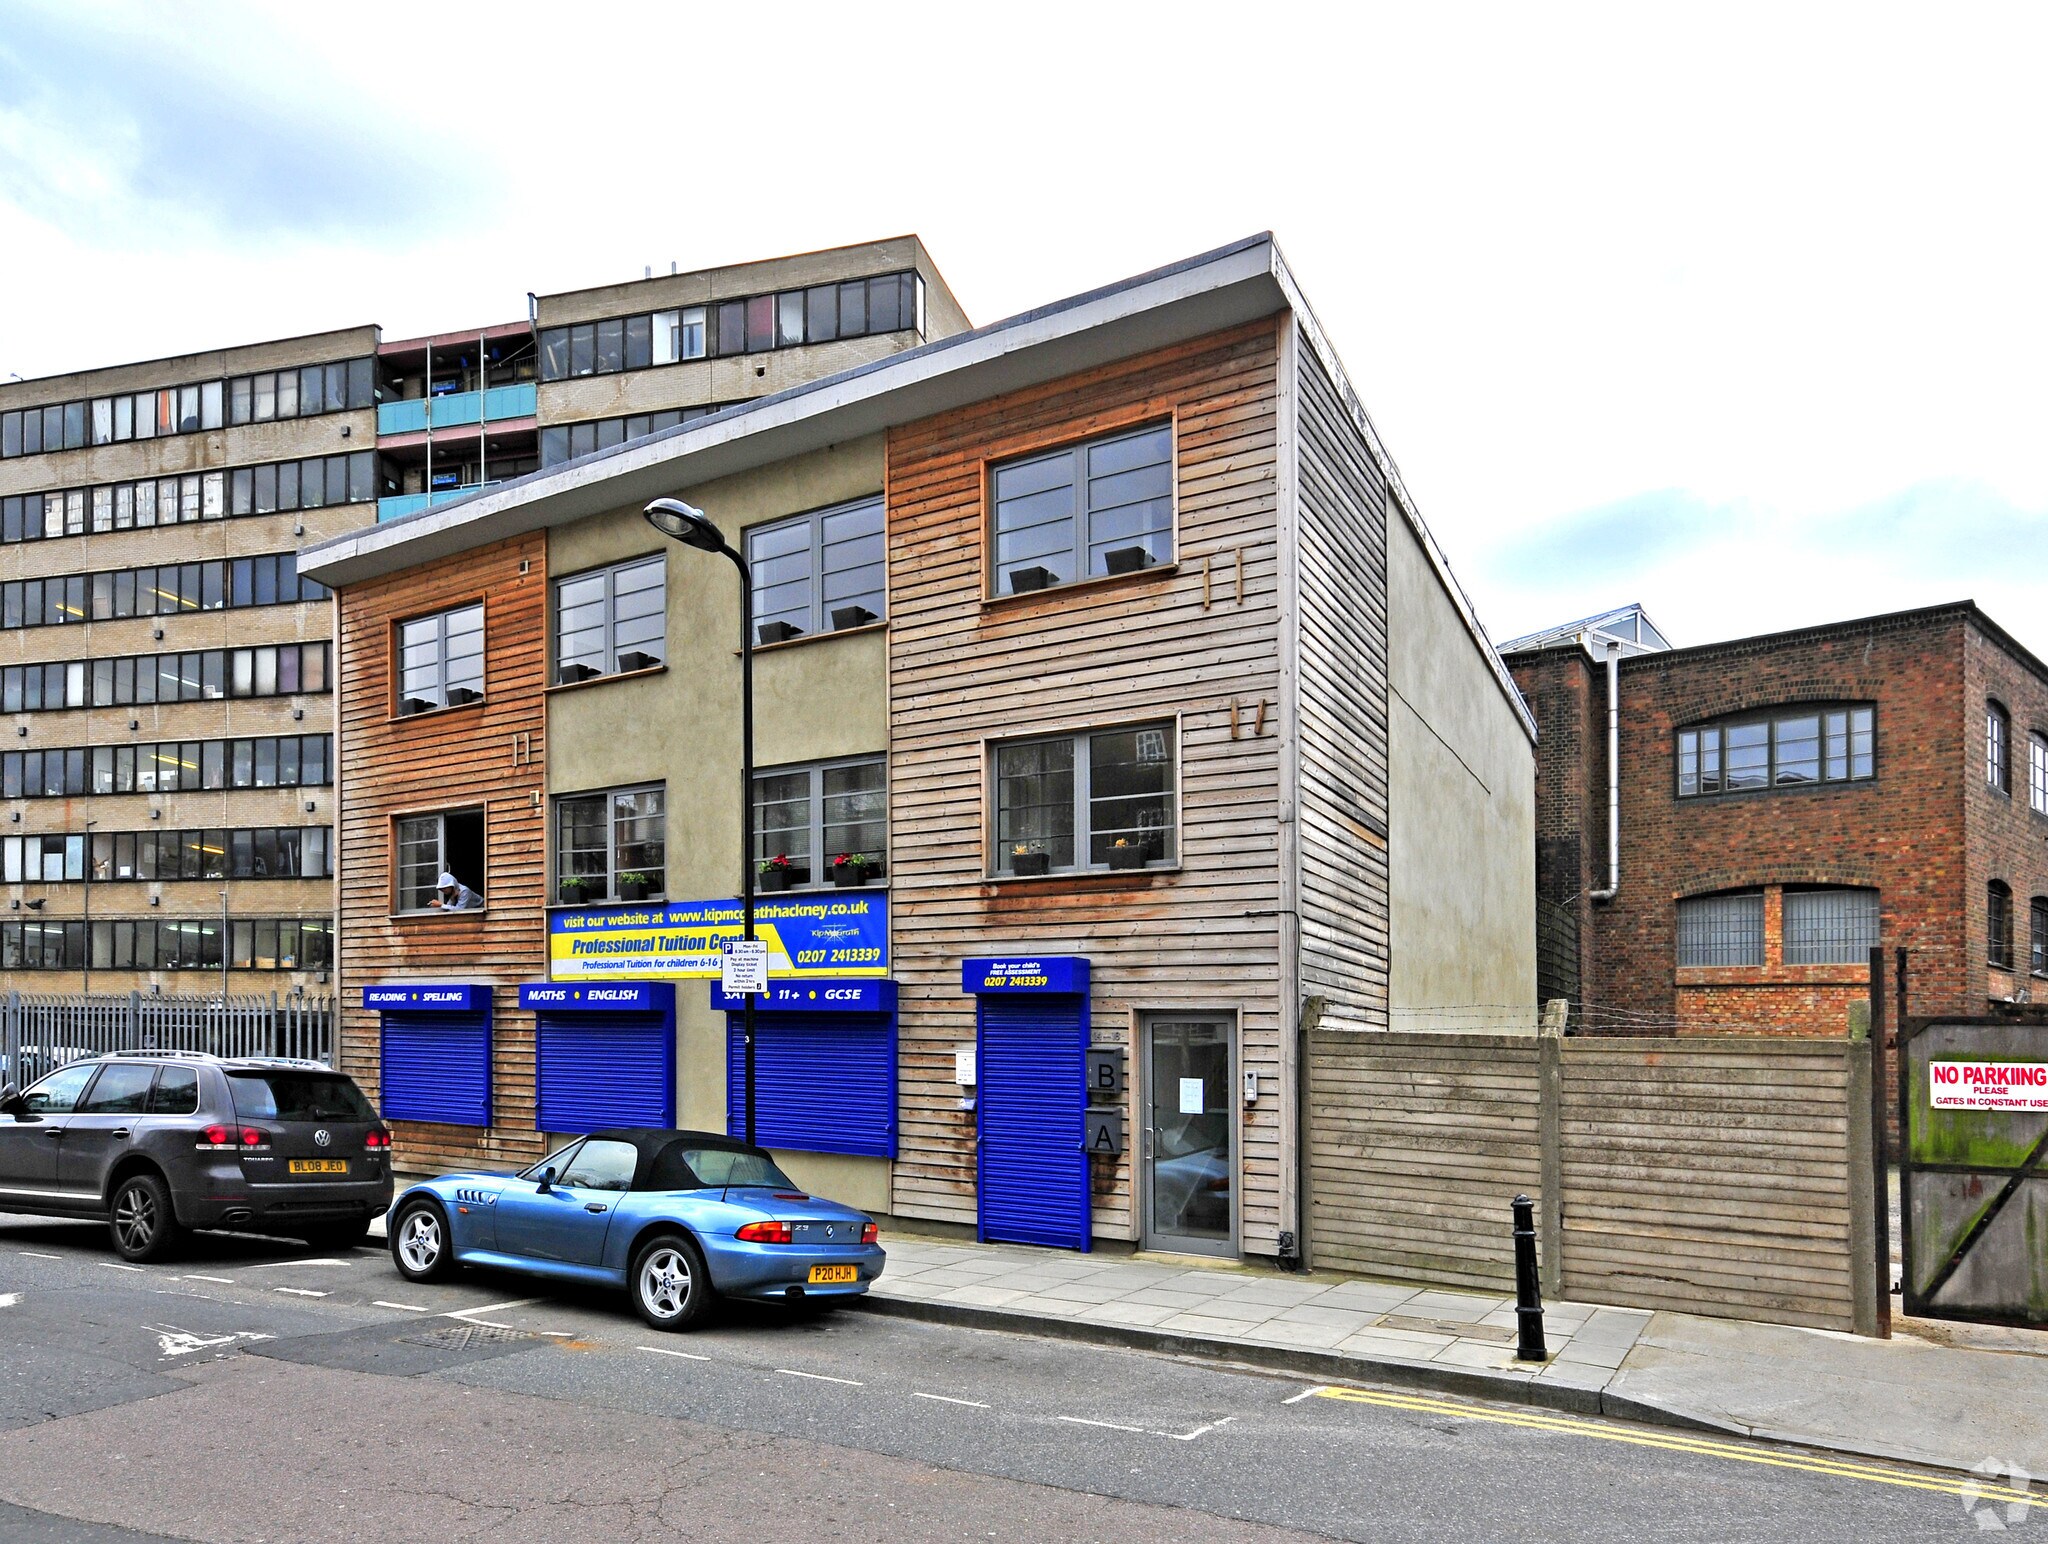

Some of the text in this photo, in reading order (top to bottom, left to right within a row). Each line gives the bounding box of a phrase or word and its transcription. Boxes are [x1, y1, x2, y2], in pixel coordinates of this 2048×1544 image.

[563, 900, 870, 929] visit our website at www.kipmcgathhackney.co.uk
[572, 936, 656, 955] Professional
[658, 934, 707, 952] Tuition
[796, 947, 881, 963] 0207 2413339
[582, 959, 626, 970] Professional
[626, 959, 652, 969] Tuition
[654, 959, 667, 969] for
[666, 958, 698, 969] children
[699, 959, 719, 968] 6-16
[992, 961, 1041, 972] Book your child's
[1003, 968, 1042, 976] ASSESSMENT
[983, 975, 1049, 987] 0207 2413339
[368, 992, 463, 1002] READING SPELLING
[527, 989, 639, 1001] MATHS ENGLISH
[724, 989, 862, 1000] SAT 11+ GCSE
[1099, 1063, 1115, 1088] B
[1934, 1066, 2047, 1087] NO PARKIING
[1973, 1086, 2009, 1095] PLEASE
[1935, 1097, 2048, 1108] GATES IN CONSTANT USE
[1094, 1124, 1114, 1149] A
[294, 1160, 322, 1172] BL08
[815, 1266, 852, 1282] P20 HJH
